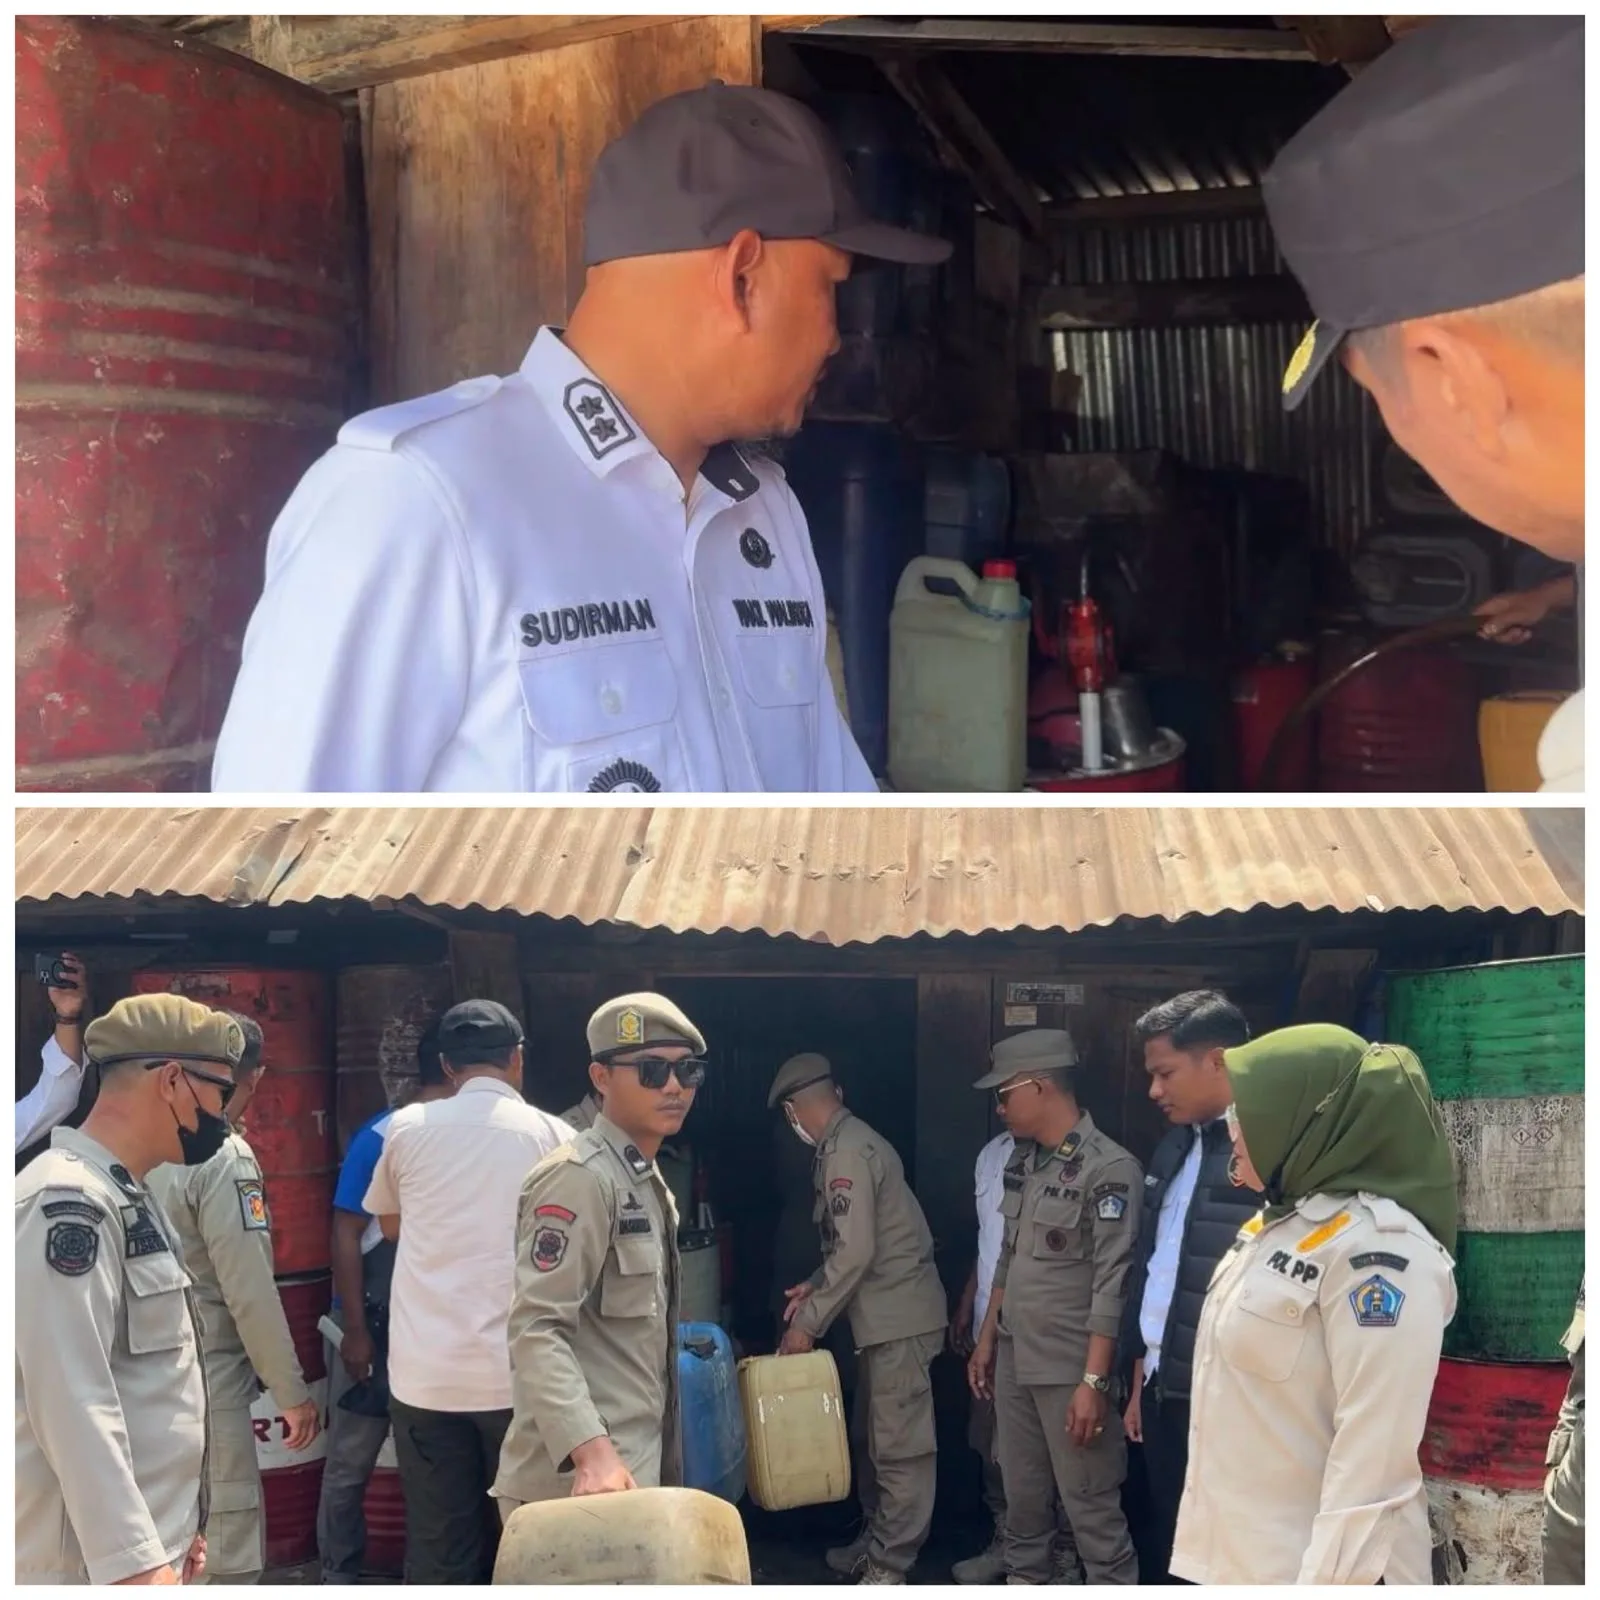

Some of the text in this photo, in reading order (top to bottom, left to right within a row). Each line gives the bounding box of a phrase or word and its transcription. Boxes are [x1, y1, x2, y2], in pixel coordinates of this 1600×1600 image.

[520, 599, 656, 648] SUDIRMAN
[1266, 1250, 1319, 1283] POL PP
